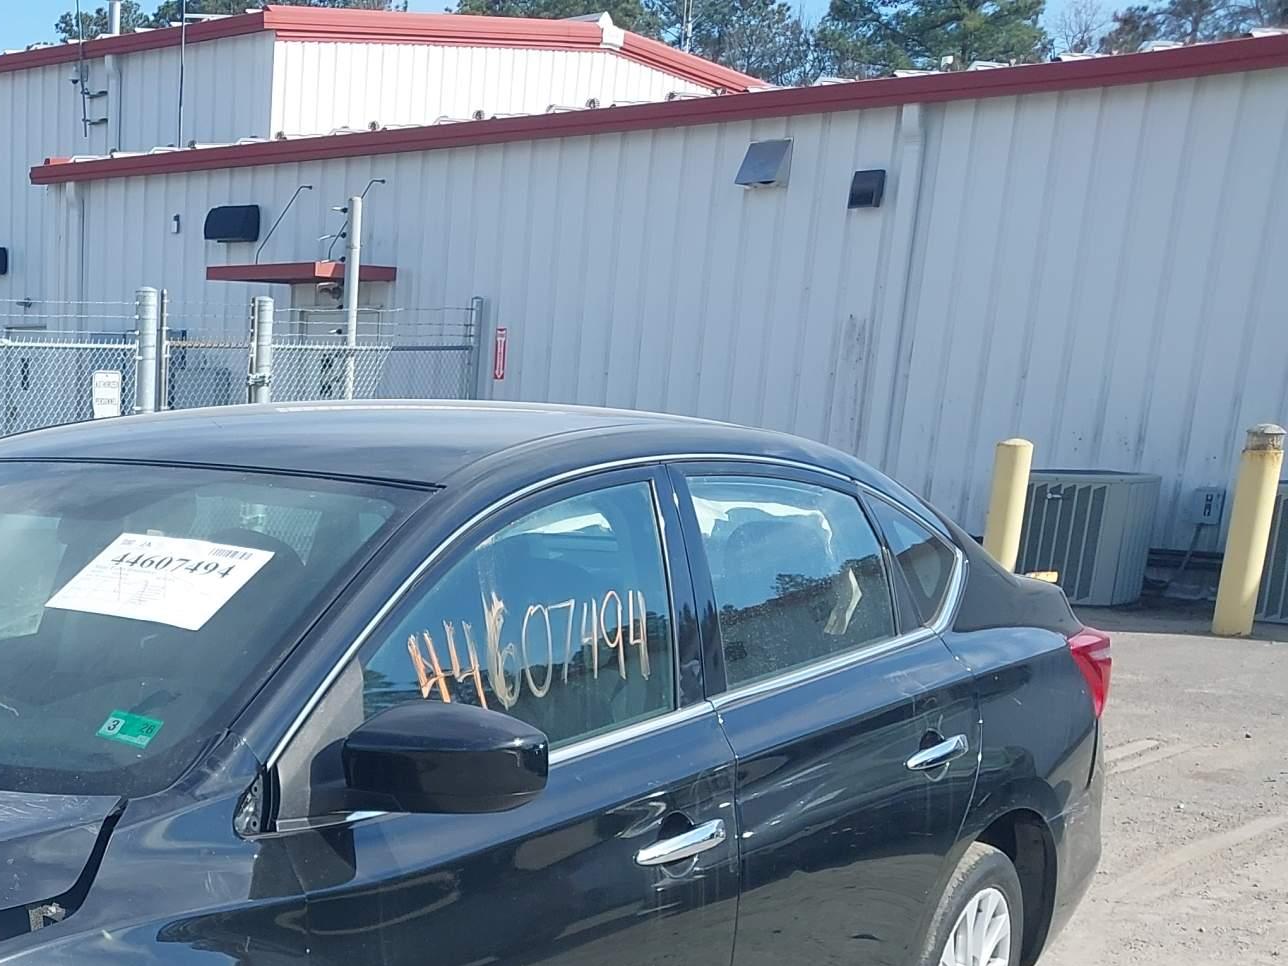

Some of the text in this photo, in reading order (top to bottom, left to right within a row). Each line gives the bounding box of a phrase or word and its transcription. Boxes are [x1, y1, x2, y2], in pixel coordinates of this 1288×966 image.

[112, 551, 237, 579] 44607494
[407, 590, 650, 711] 44607494
[107, 719, 120, 731] 3
